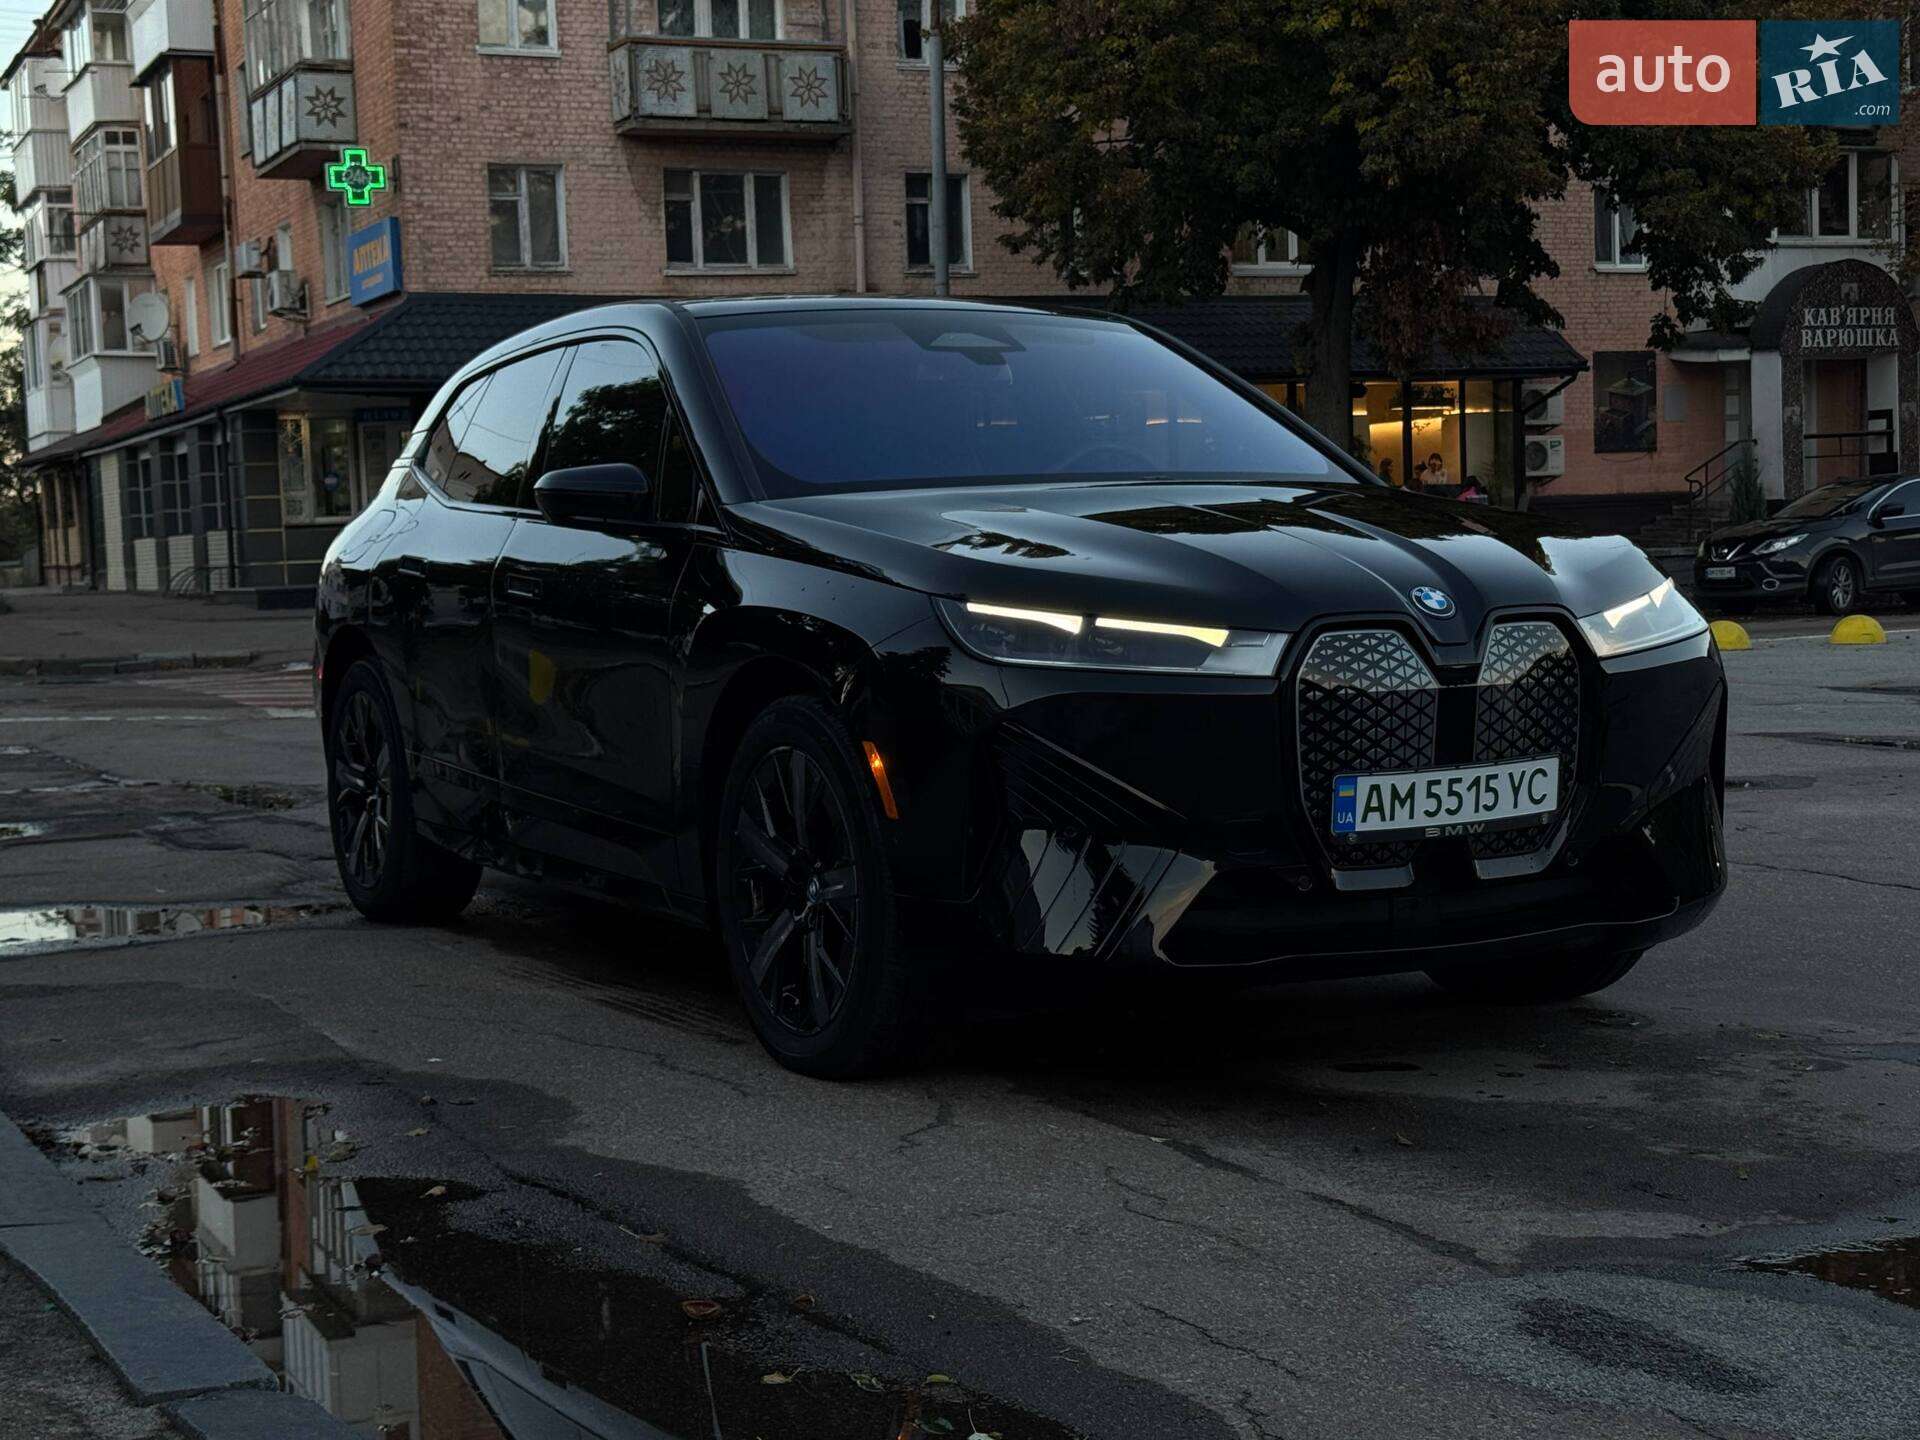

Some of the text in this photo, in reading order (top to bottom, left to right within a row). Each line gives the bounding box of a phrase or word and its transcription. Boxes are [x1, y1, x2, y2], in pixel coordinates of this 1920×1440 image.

[1800, 328, 1900, 347] ВАРЮШКА
[1361, 767, 1548, 823] AM 5515 YC
[1337, 812, 1353, 824] UA
[1425, 823, 1486, 838] BMW
